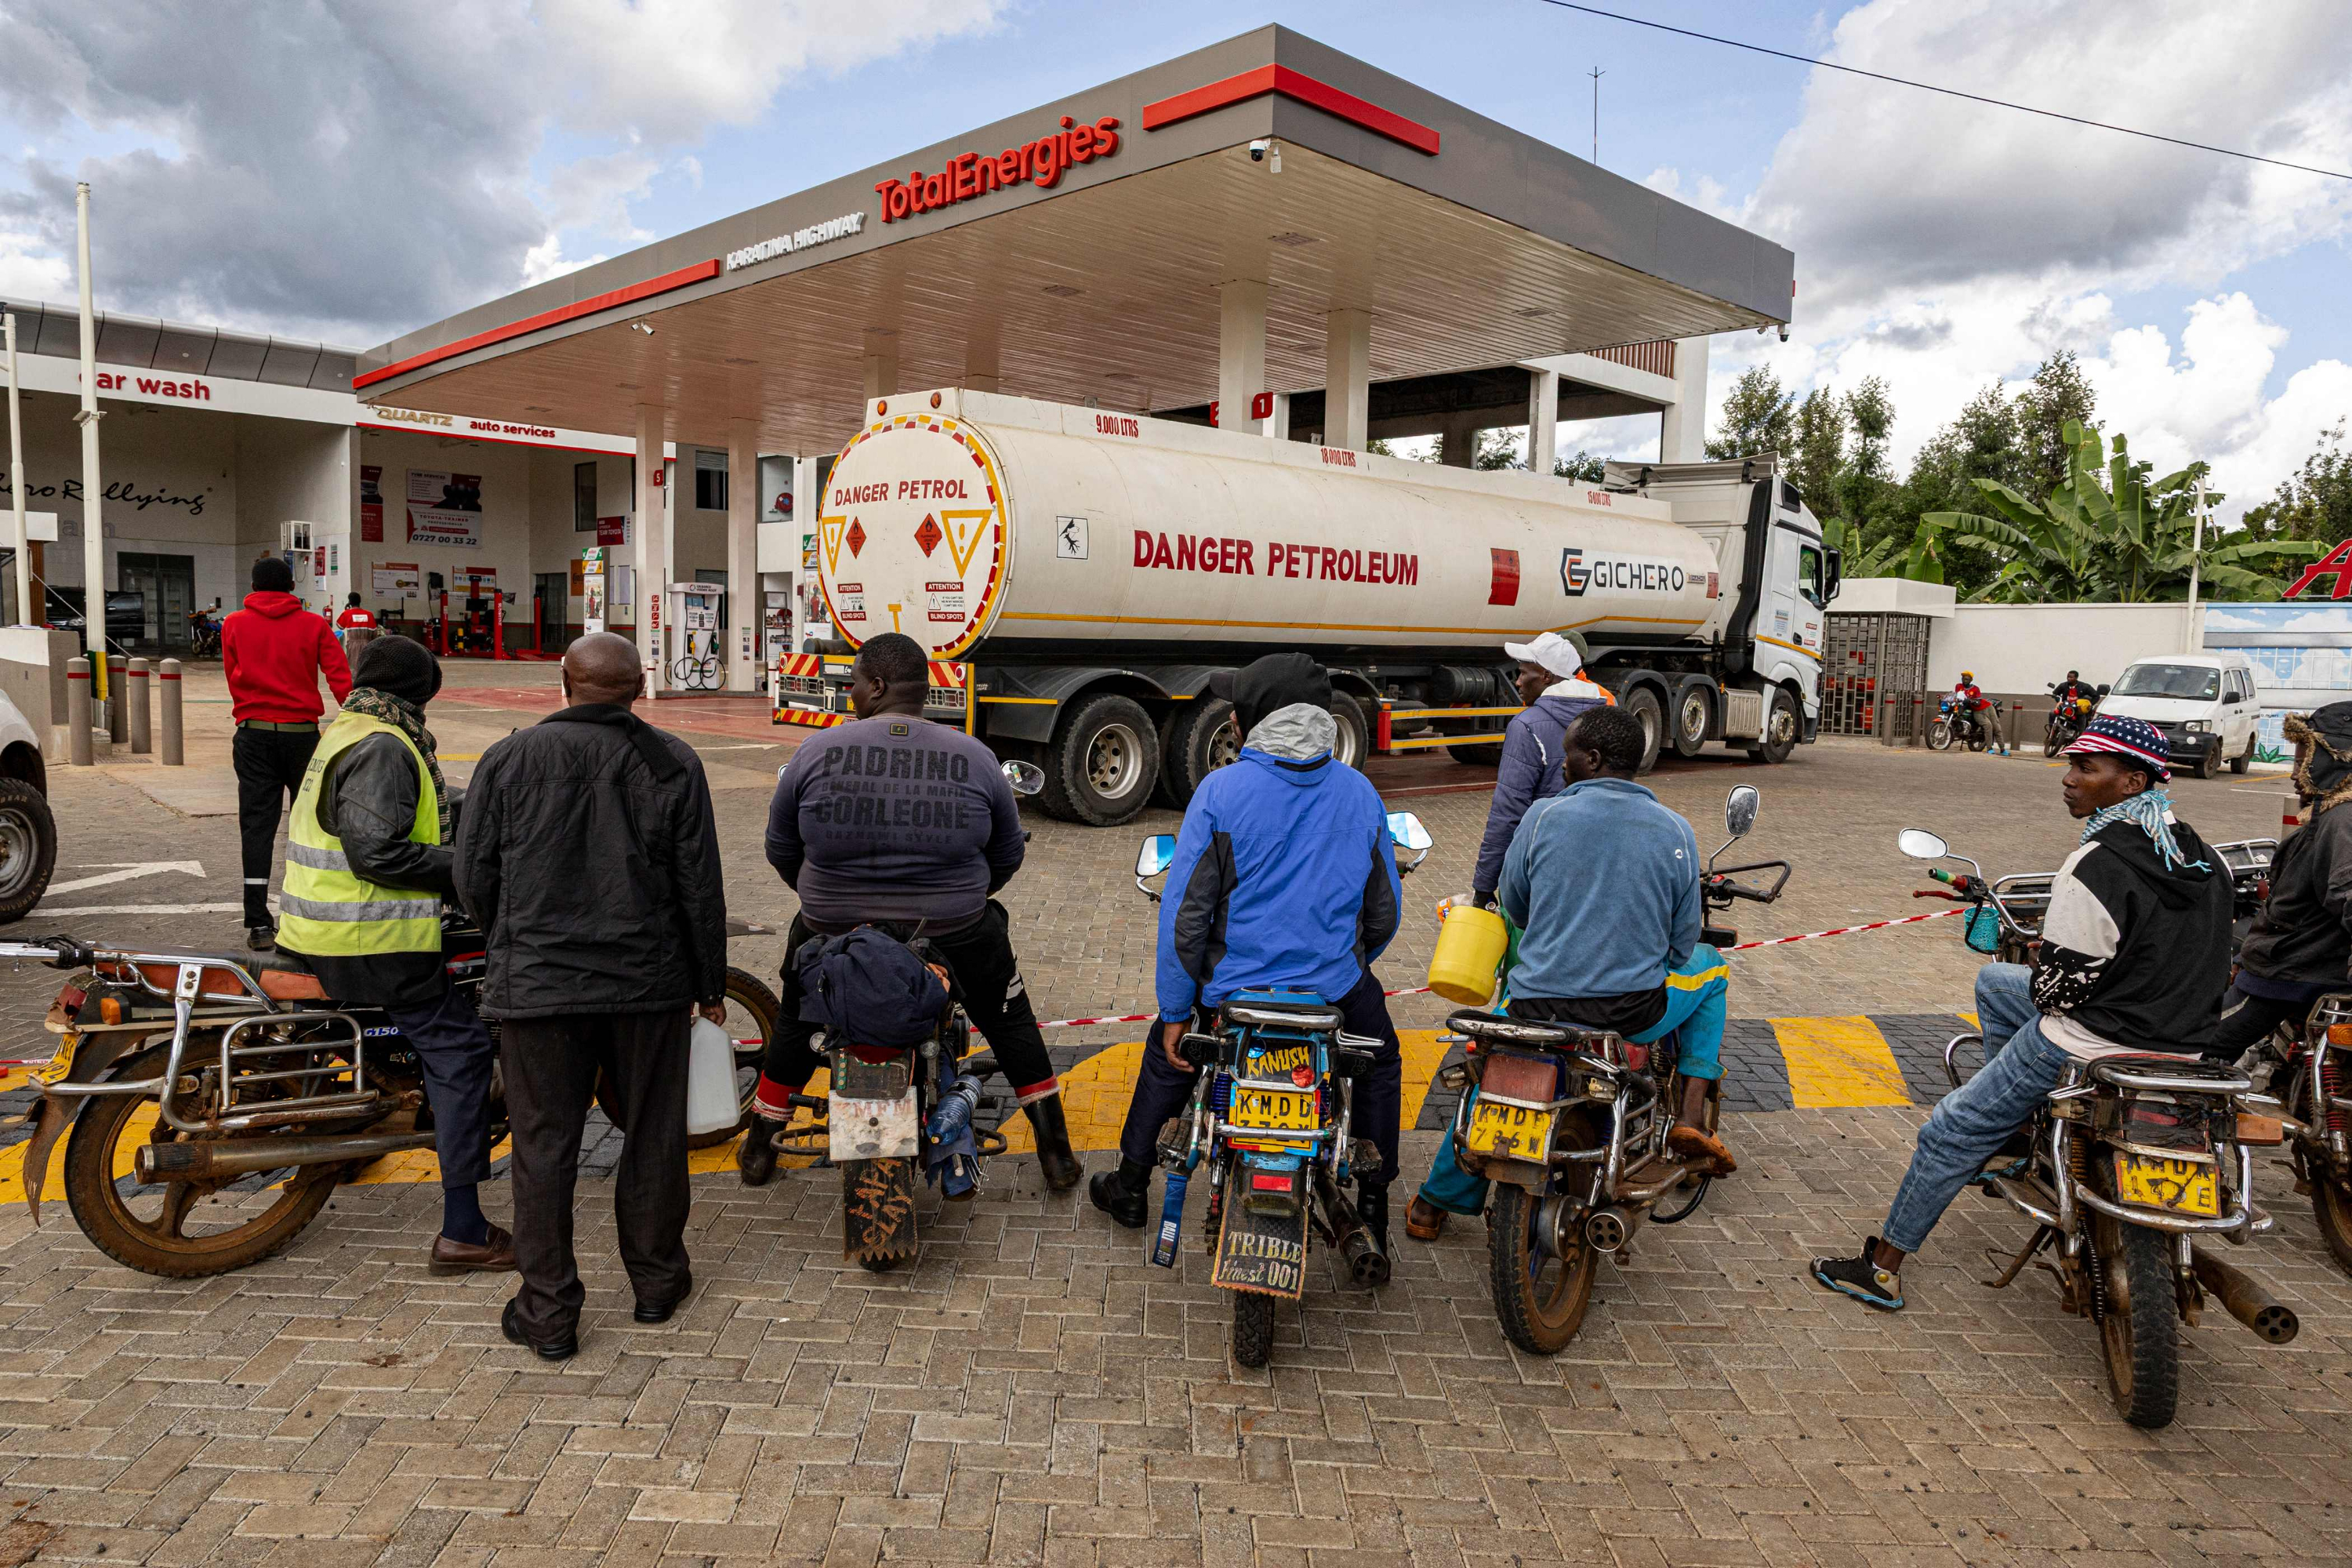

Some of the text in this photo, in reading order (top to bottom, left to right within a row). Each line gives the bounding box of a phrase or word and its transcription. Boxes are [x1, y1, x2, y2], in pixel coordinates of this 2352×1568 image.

[875, 115, 1120, 223] TotalEnergies
[727, 212, 864, 270] KARATINA HIGHWAY
[79, 372, 210, 401] ar wash
[376, 408, 453, 426] QUARTZ
[1259, 398, 1265, 413] 1
[470, 419, 556, 438] auto services
[1120, 417, 1138, 438] LTRS
[1341, 450, 1356, 467] LTRS
[656, 473, 661, 483] 5
[835, 479, 968, 506] DANGER PETROL
[62, 479, 205, 515] Rllying
[927, 543, 931, 551] 3
[1134, 530, 1418, 586] DANGER PETROLEUM
[1594, 561, 1684, 592] GICHERO
[822, 745, 969, 784] PADRINO
[822, 781, 966, 798] GENERAL DE LA MAFIA
[815, 795, 969, 829] CORLEONE
[906, 833, 953, 844] STYLE
[1245, 1045, 1310, 1078] KANUSH
[1228, 1231, 1302, 1264] TRIBLE
[1268, 1261, 1298, 1290] 001
